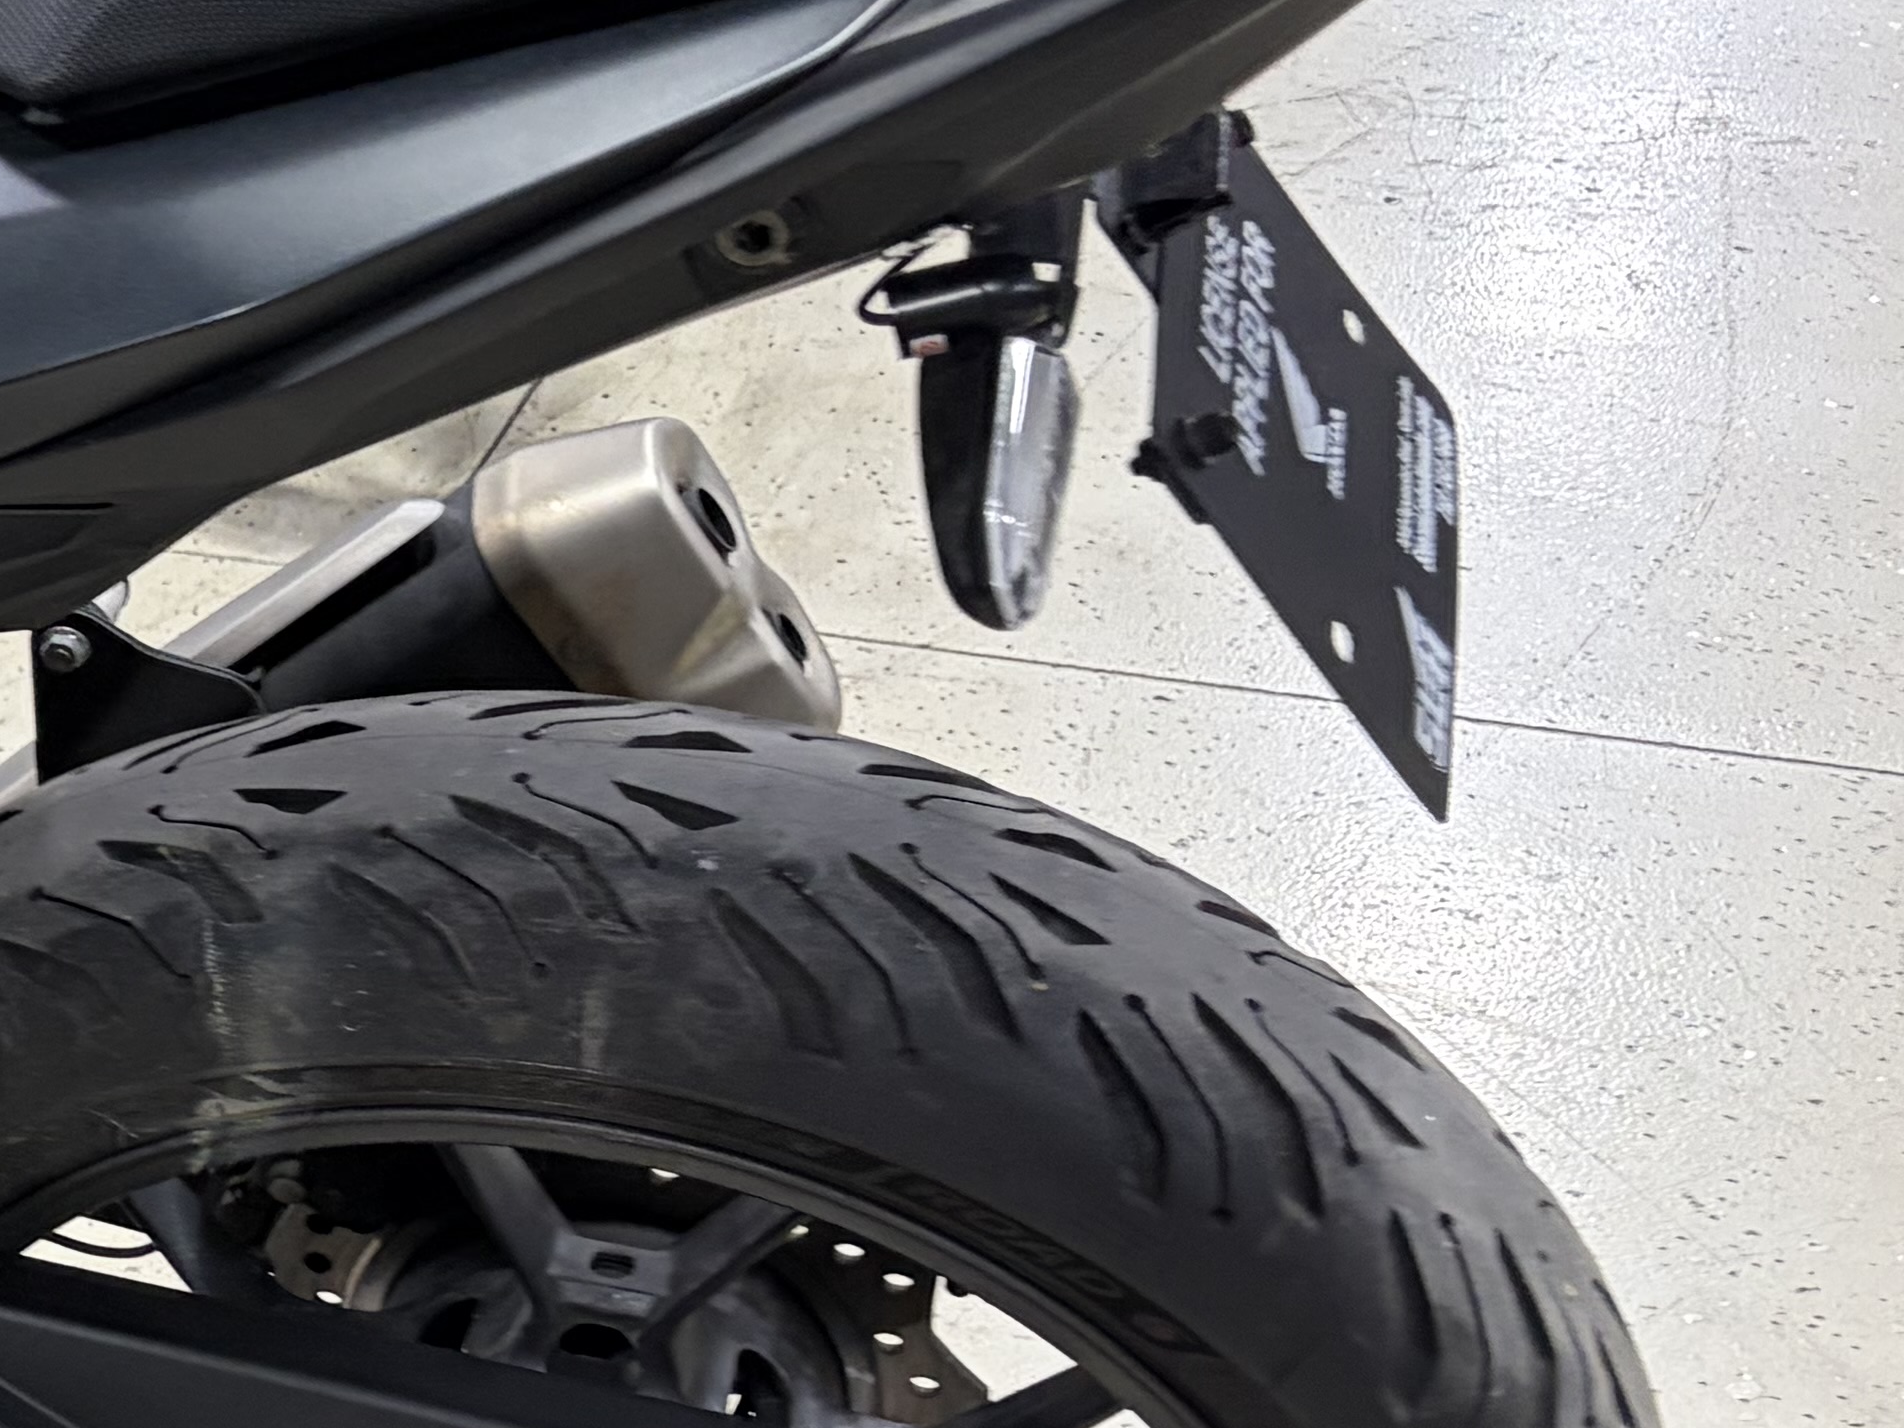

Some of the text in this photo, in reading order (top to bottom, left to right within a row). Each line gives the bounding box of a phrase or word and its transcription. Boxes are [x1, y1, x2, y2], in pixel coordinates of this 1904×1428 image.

[1198, 215, 1240, 384] LICENSE
[1233, 218, 1276, 476] APPLIED FOR
